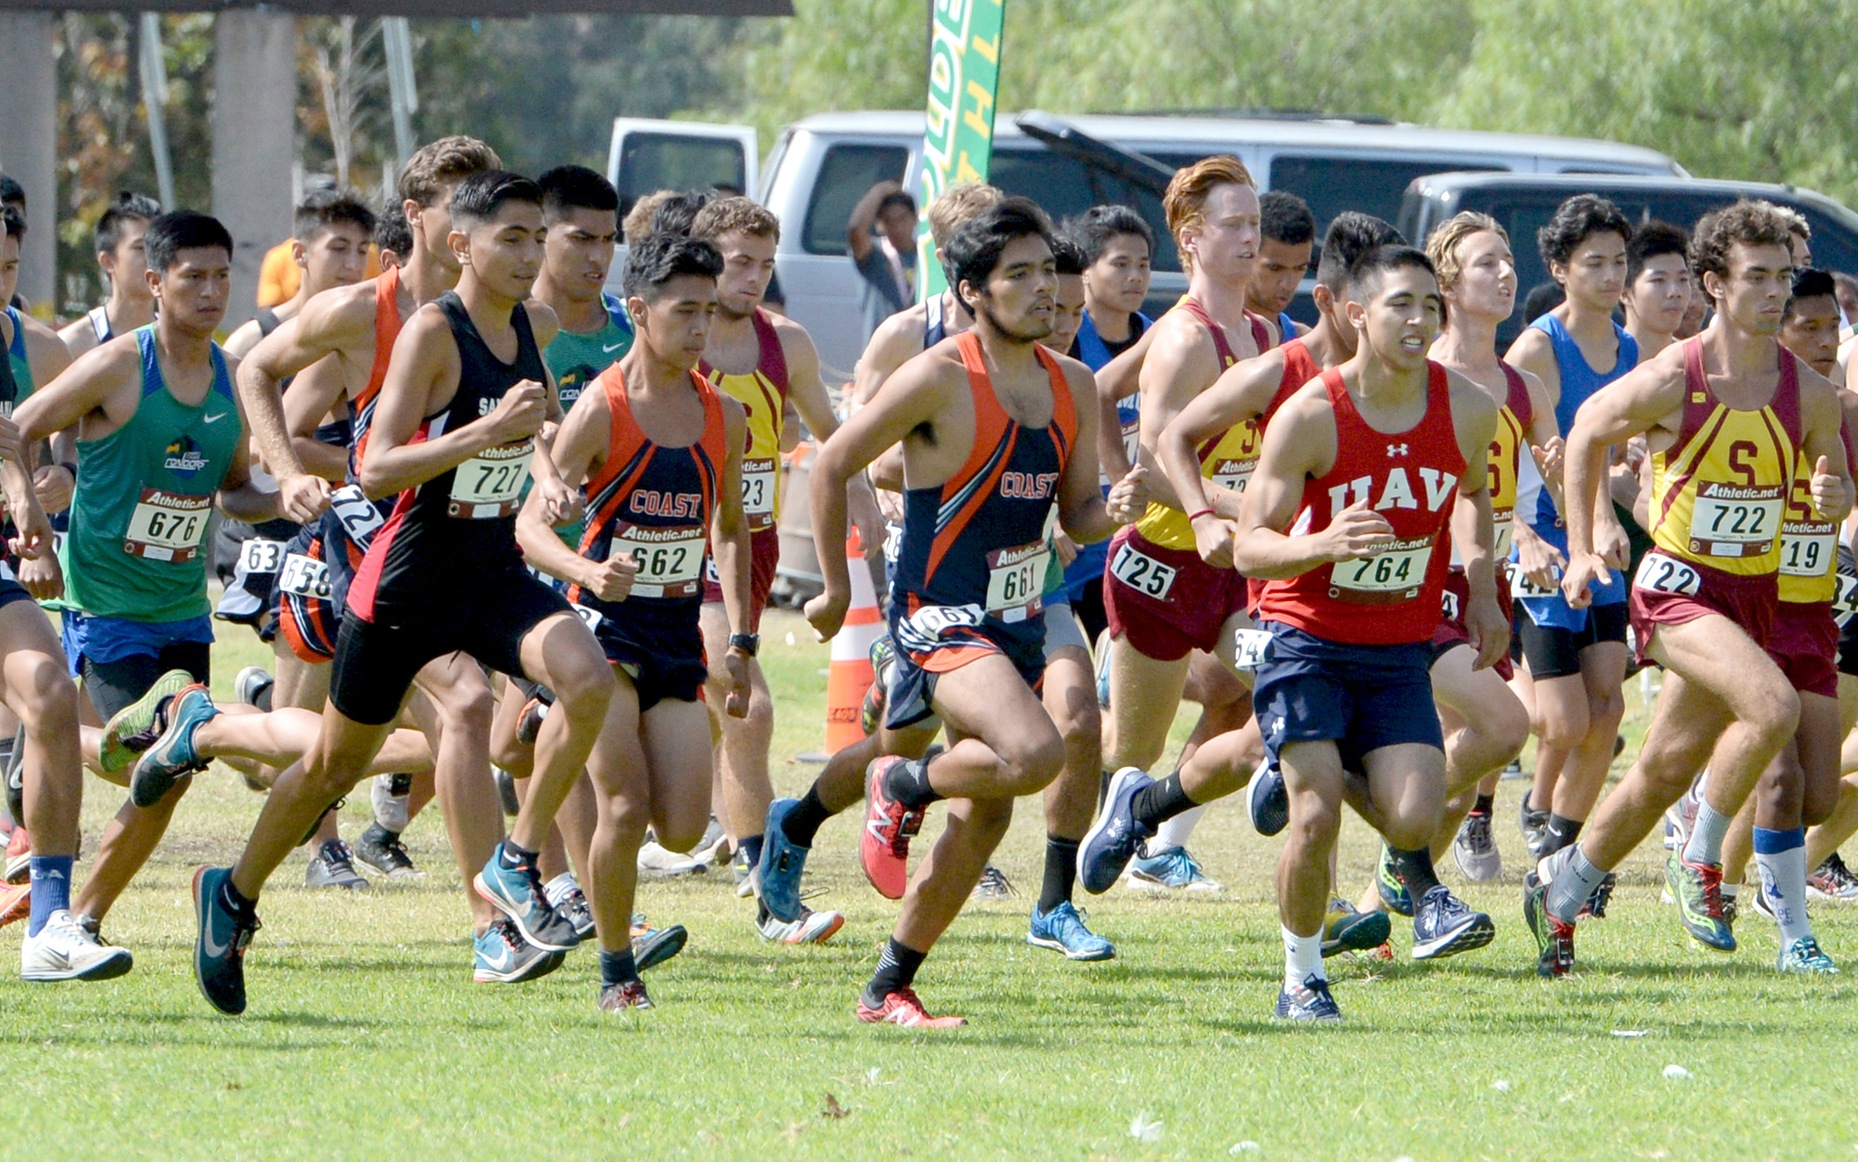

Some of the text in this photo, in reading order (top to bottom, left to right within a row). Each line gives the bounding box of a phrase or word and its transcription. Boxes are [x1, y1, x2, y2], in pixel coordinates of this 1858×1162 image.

[478, 397, 502, 417] SA
[1729, 440, 1758, 485] S
[474, 463, 523, 494] 727
[1000, 471, 1060, 499] COAST
[1328, 466, 1458, 518] UAV
[1703, 483, 1778, 499] Athletic.net
[146, 491, 210, 509] Athletic.net
[630, 490, 702, 518] COAST
[148, 512, 197, 542] 676
[1711, 505, 1766, 534] 722
[621, 526, 702, 542] Athletic.net
[248, 543, 280, 571] 63
[632, 547, 687, 576] 662
[1781, 541, 1820, 568] 19
[284, 558, 331, 597] 658
[1003, 562, 1035, 601] 661
[1116, 546, 1170, 595] 725
[1353, 557, 1410, 583] 764
[1642, 557, 1695, 596] 722
[920, 606, 977, 633] 661
